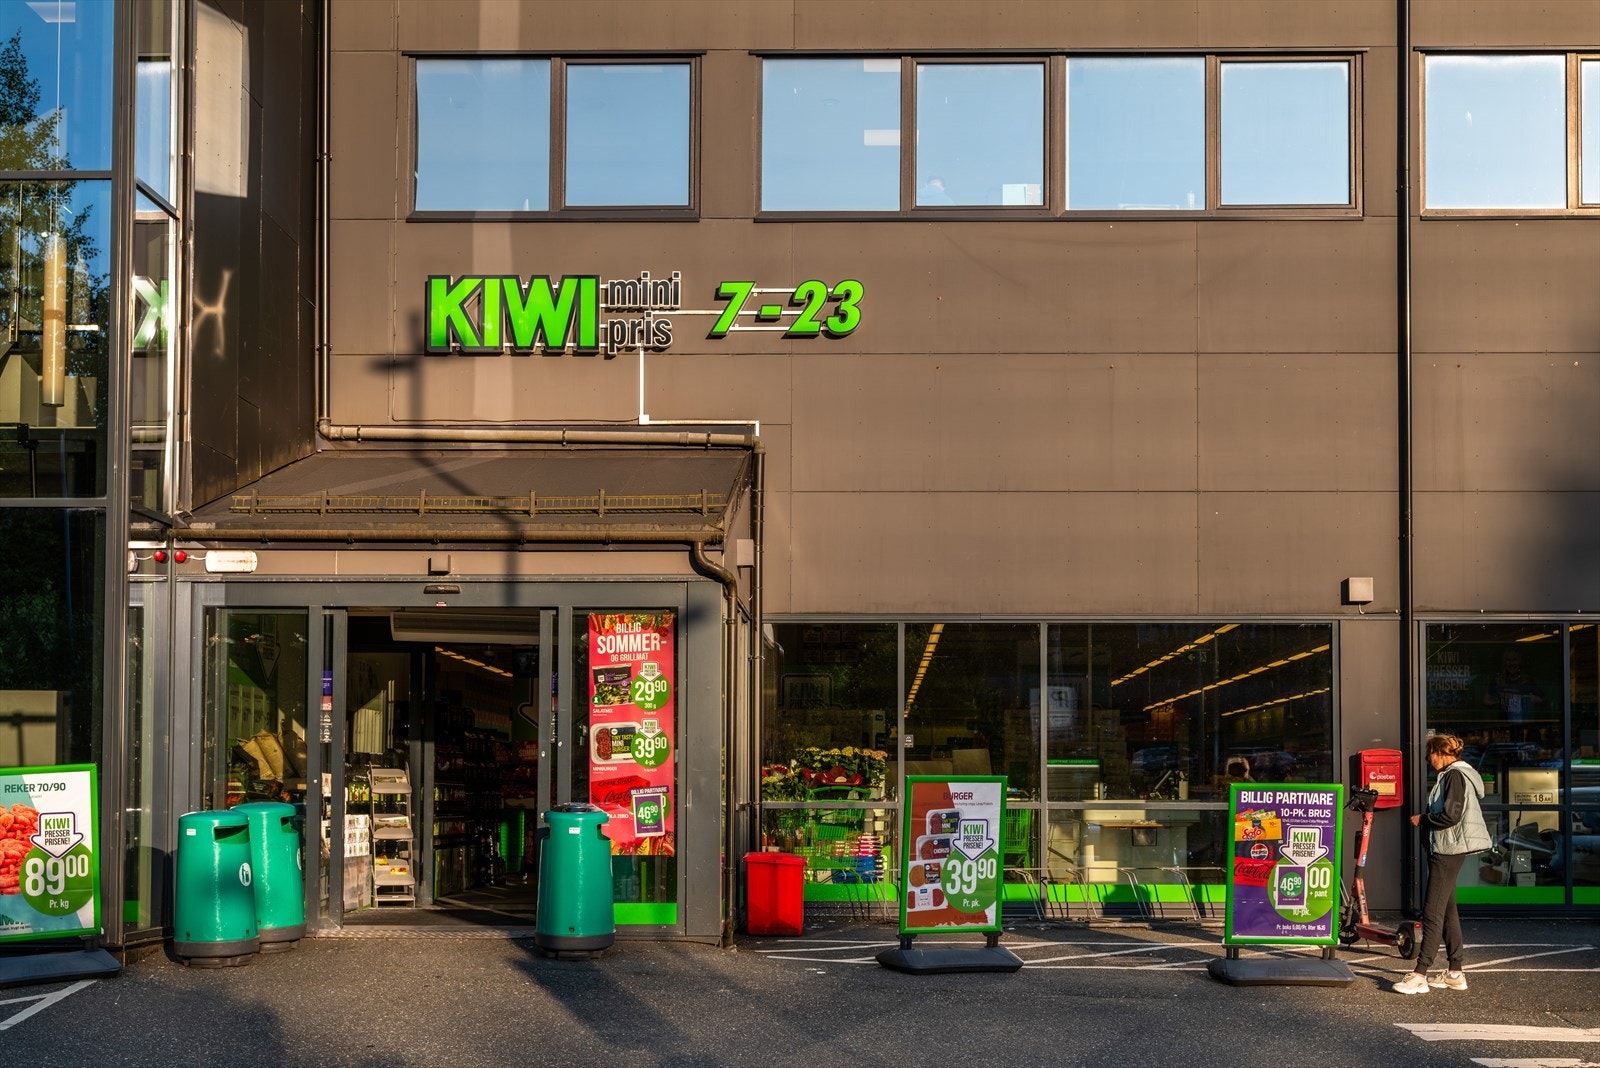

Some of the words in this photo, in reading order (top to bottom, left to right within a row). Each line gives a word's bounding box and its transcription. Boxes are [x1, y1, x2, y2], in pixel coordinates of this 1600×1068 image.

[608, 271, 681, 310] mini
[711, 281, 755, 335] 7
[787, 280, 865, 335] 23
[426, 276, 599, 351] KIWI
[608, 311, 673, 353] pris
[616, 622, 642, 634] BILLIG
[597, 633, 667, 654] SOMMER-
[620, 652, 649, 661] GRILLMAT
[1437, 651, 1459, 664] KIWI
[1426, 664, 1470, 677] PRESSER
[1428, 678, 1469, 691] PRISENE
[4, 784, 35, 793] REKER
[37, 782, 66, 792] 70/90
[943, 792, 974, 800] BURGER
[1241, 791, 1273, 803] BILLIG
[1276, 792, 1333, 805] PARTIVARE
[1281, 808, 1306, 817] 10-PK.
[1308, 808, 1331, 818] BRUS
[44, 818, 70, 829] KIWI
[963, 824, 984, 834] KIWI
[44, 830, 70, 838] PRESSER
[1293, 832, 1316, 842] KIWI
[44, 838, 70, 846] PRISENE!
[50, 899, 58, 908] Pr.
[60, 899, 69, 909] kg
[971, 899, 980, 908] pk.
